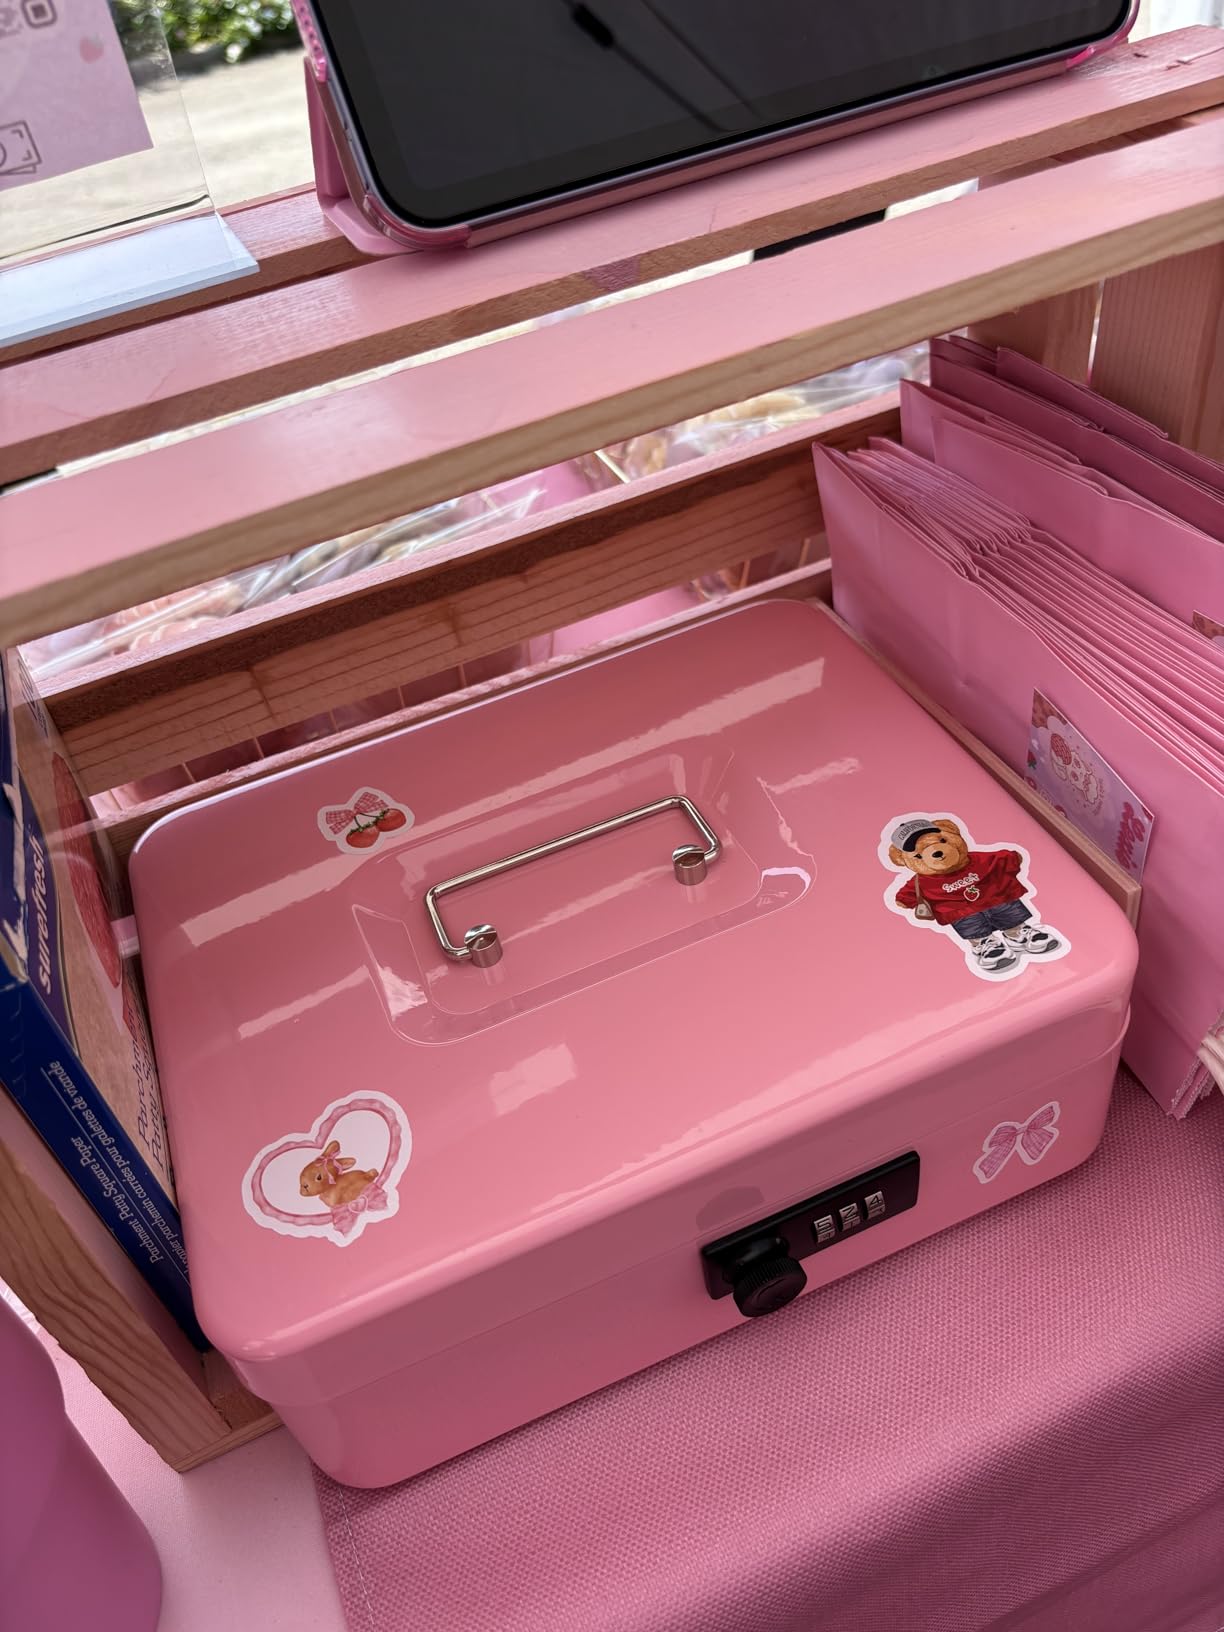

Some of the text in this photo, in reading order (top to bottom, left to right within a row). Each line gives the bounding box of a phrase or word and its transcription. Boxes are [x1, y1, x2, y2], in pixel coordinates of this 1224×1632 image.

[942, 872, 979, 893] Sweet
[29, 834, 51, 995] surefresh
[48, 1060, 78, 1098] viande
[71, 1096, 88, 1111] de
[82, 1109, 115, 1147] galettes
[106, 1145, 130, 1168] pour
[71, 1136, 164, 1264] Parchment Patty Square Paper
[121, 1166, 147, 1199] carrées
[142, 1197, 179, 1240] parchemin
